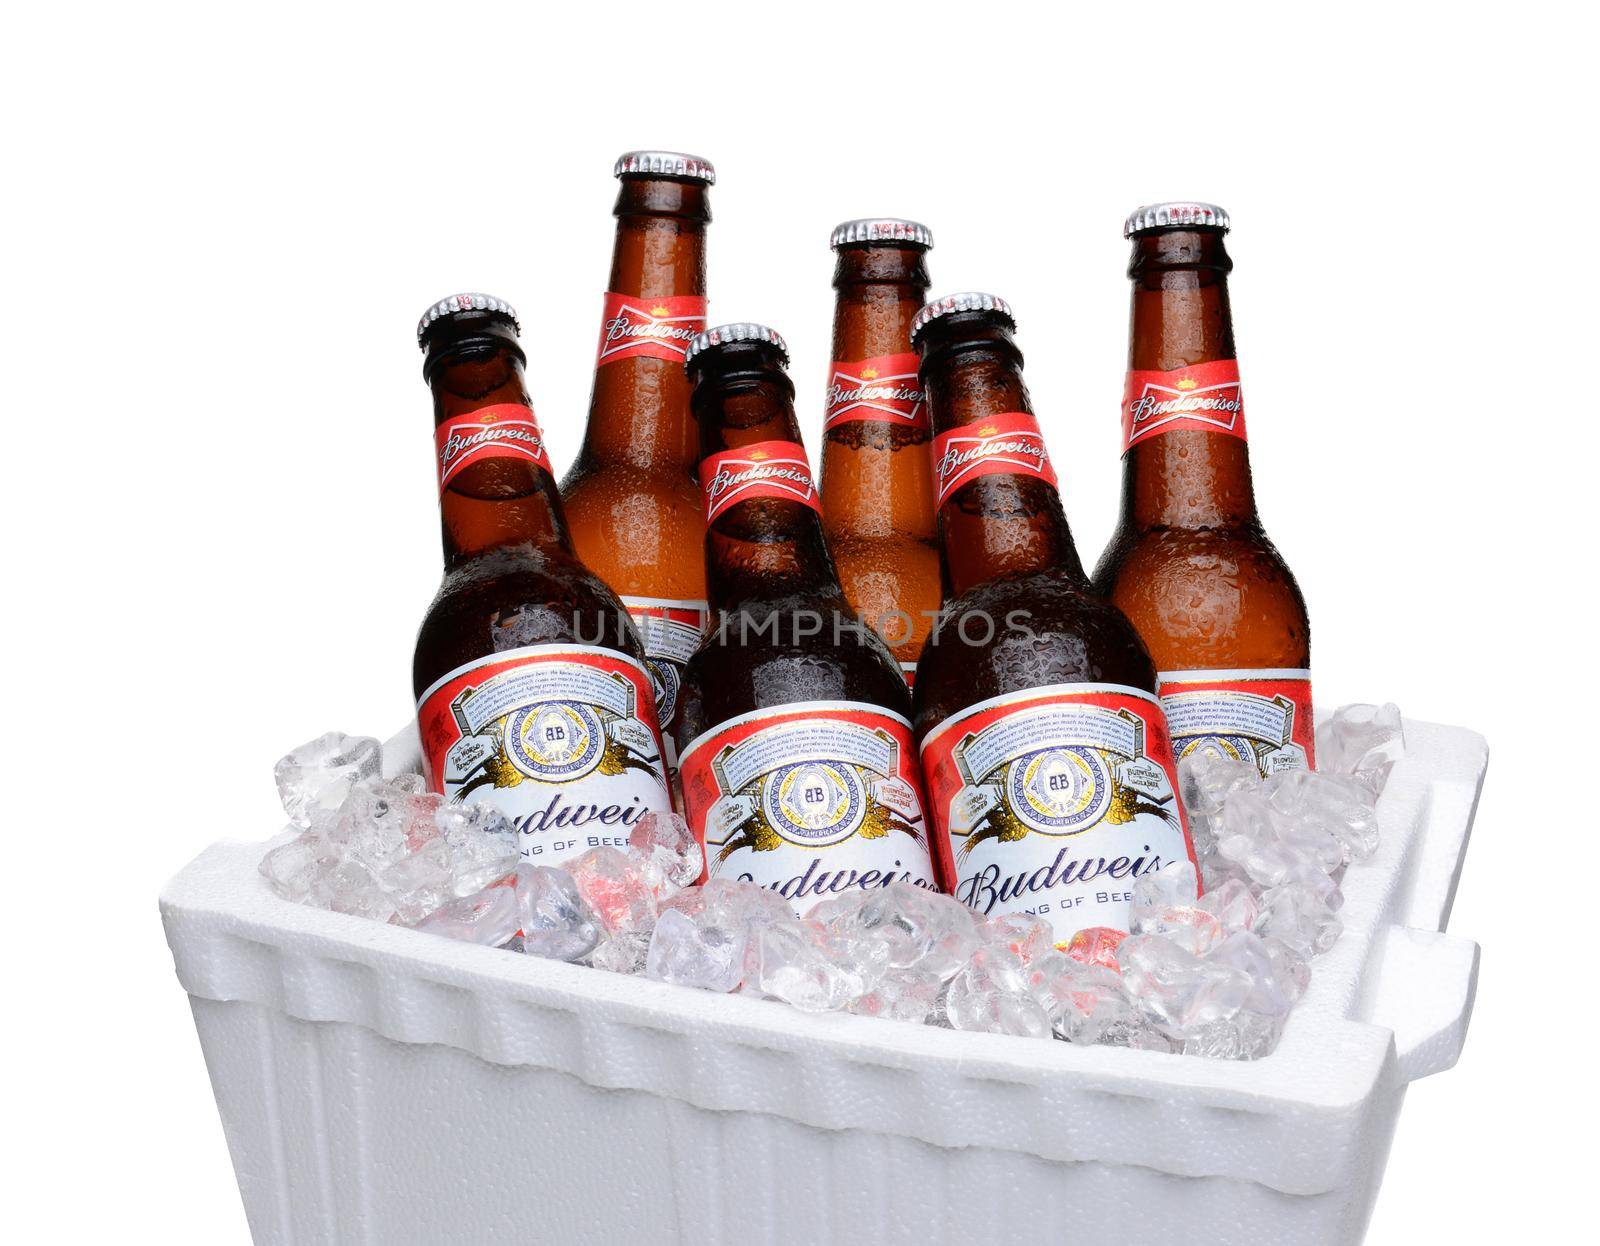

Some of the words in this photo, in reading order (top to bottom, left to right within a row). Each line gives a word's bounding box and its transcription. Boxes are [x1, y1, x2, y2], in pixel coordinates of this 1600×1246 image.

[606, 317, 701, 341] Budweis
[1130, 394, 1240, 422] Budweiser
[440, 424, 544, 465] Budweiser
[936, 439, 1048, 480] Budweiser
[706, 463, 815, 500] Budweiser
[546, 726, 565, 741] AB
[804, 787, 825, 802] AB
[1049, 774, 1070, 791] AB
[520, 846, 543, 858] NG
[554, 840, 576, 850] OF
[954, 846, 1176, 915] Budweis
[1025, 904, 1051, 916] NG
[1061, 896, 1090, 909] OF
[1096, 892, 1132, 904] BEE
